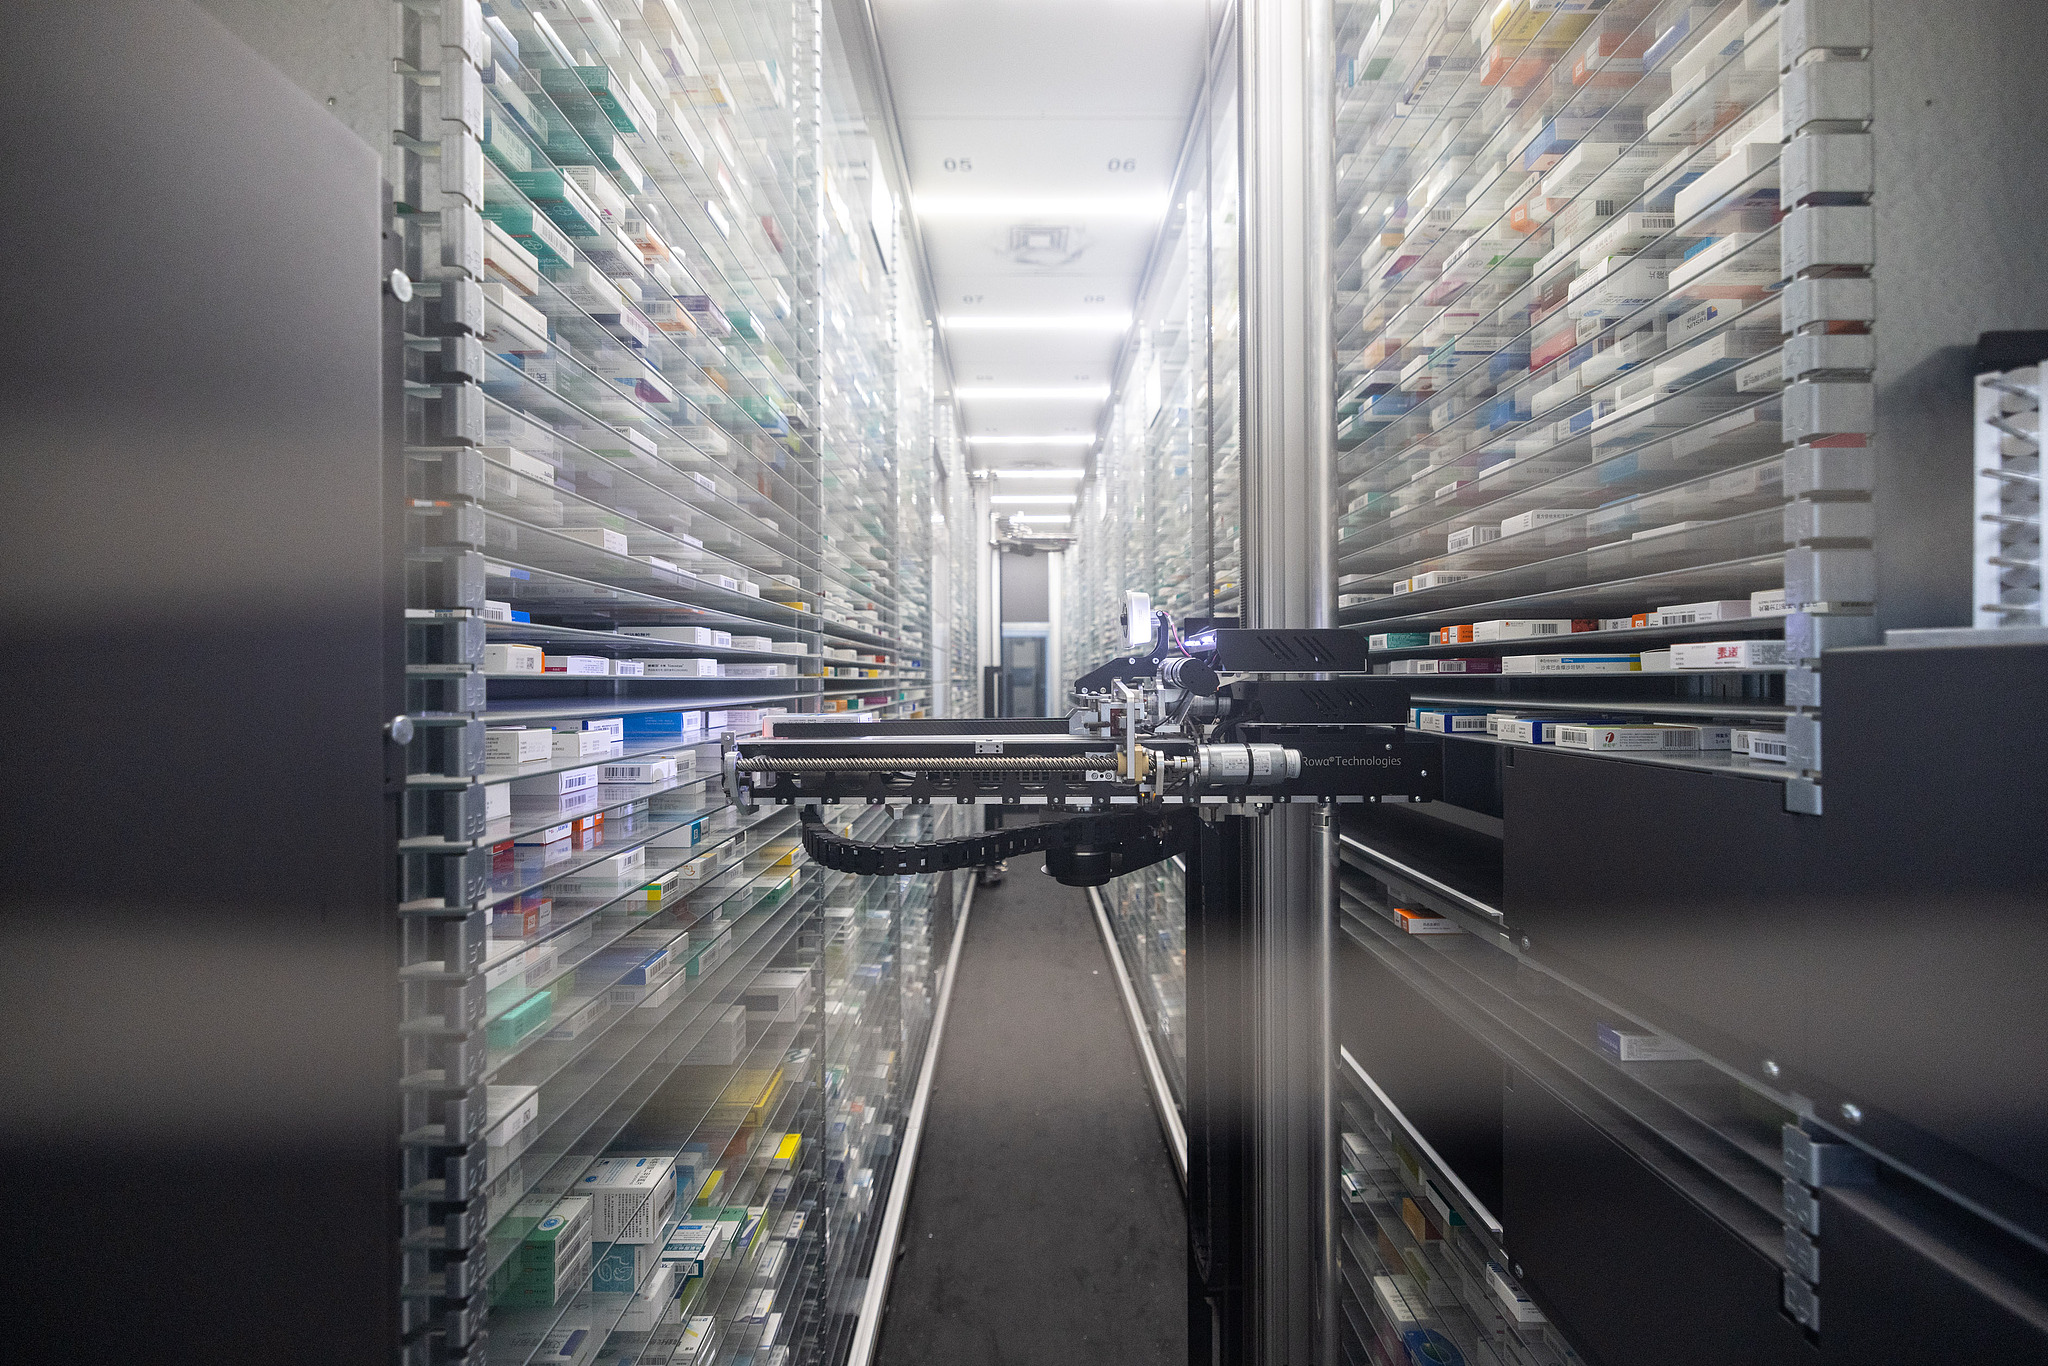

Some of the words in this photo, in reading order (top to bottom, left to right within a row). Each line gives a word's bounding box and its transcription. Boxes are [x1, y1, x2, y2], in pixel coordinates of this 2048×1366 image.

[943, 158, 972, 172] 05
[1107, 158, 1136, 172] 06
[1335, 755, 1402, 768] Technologies
